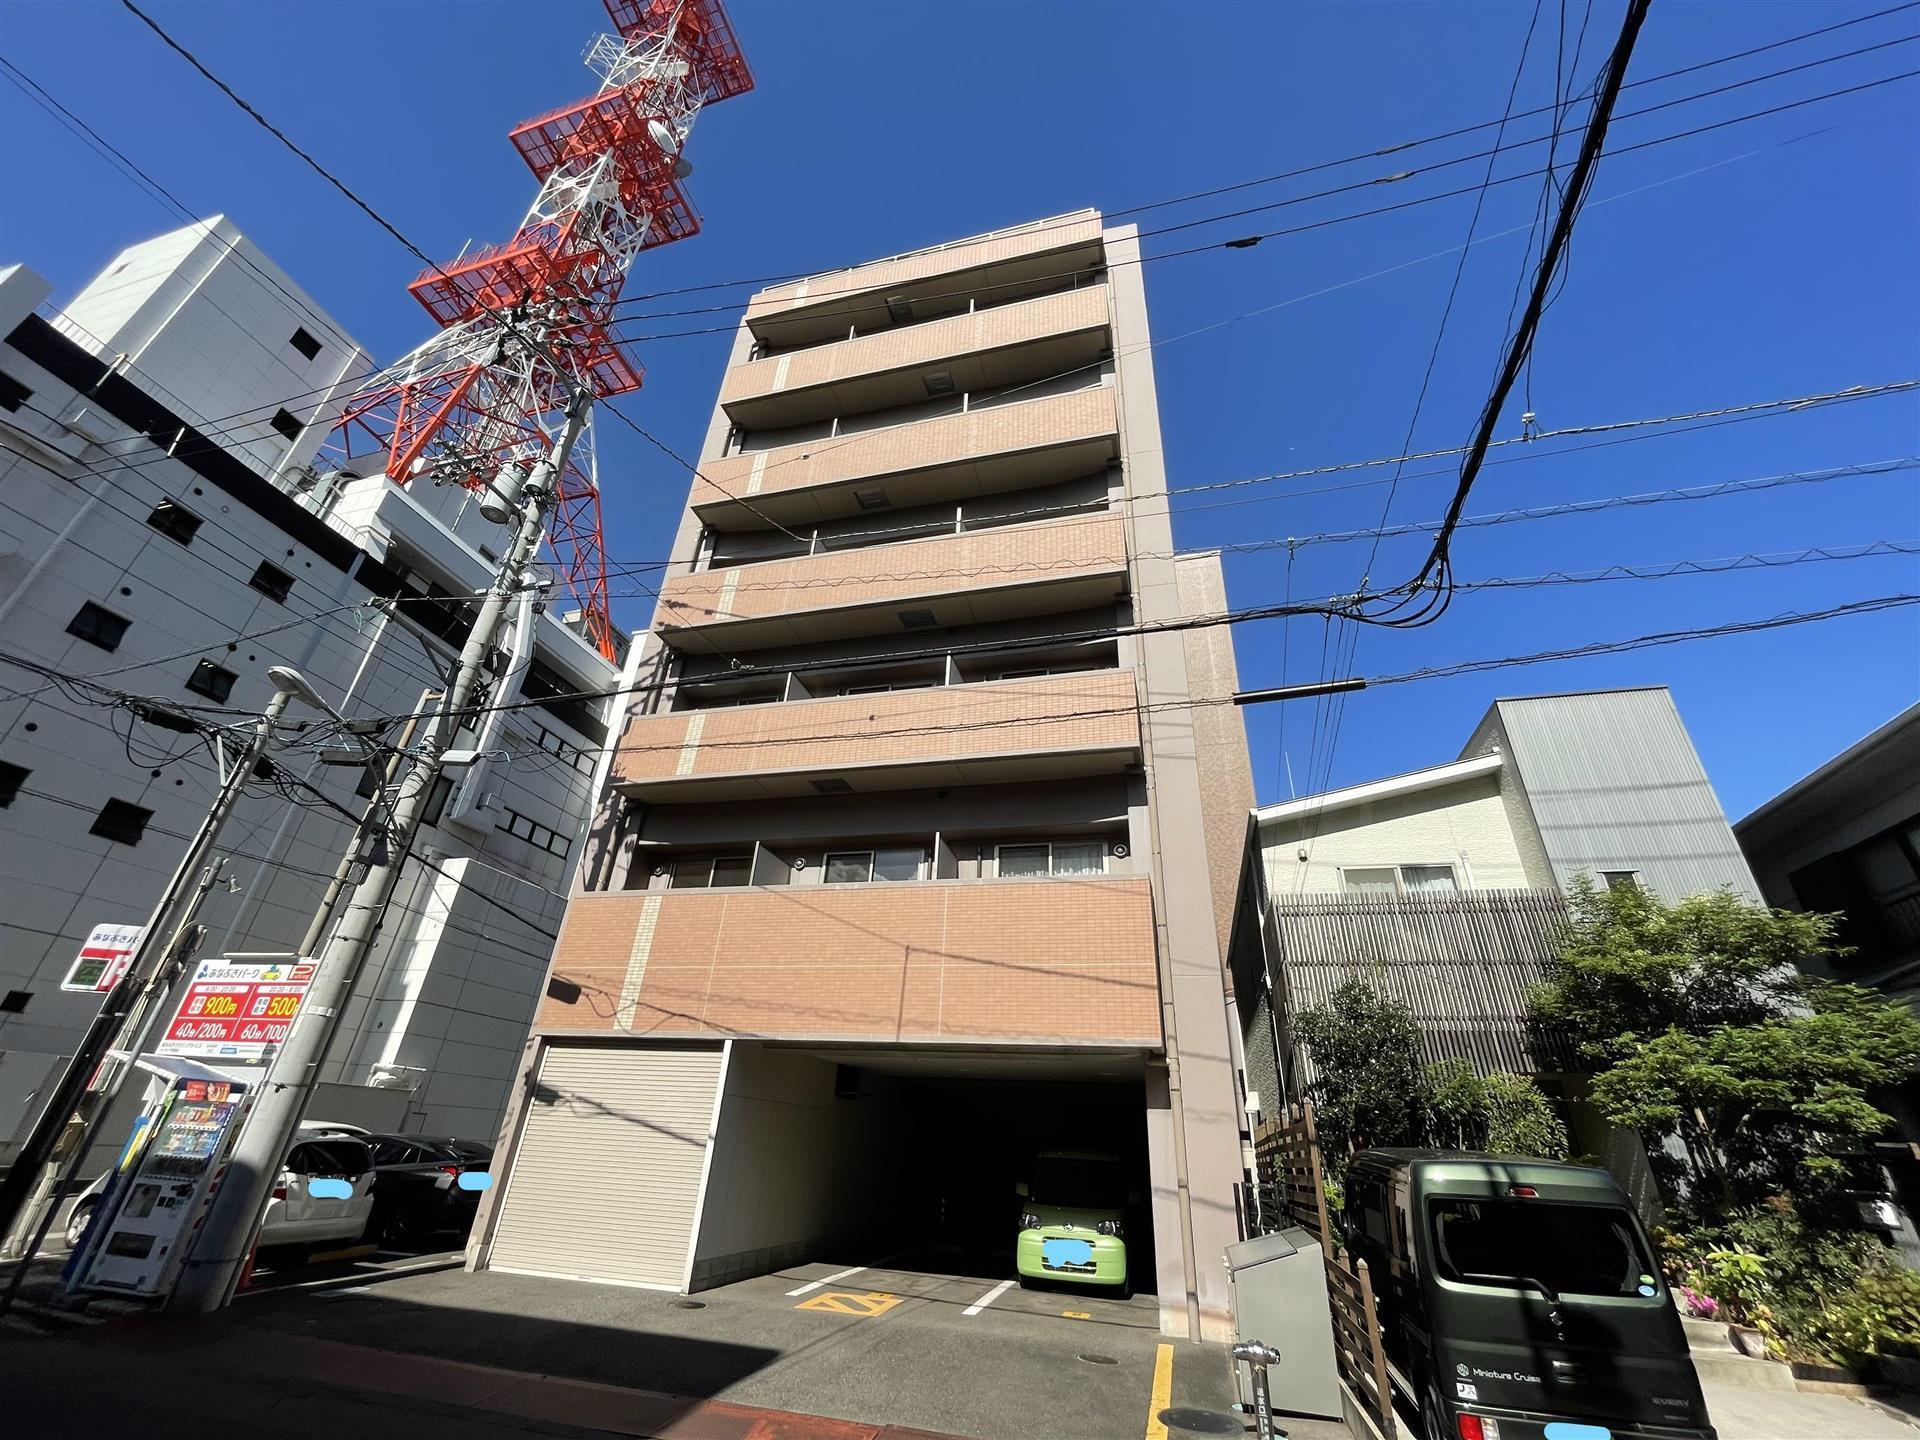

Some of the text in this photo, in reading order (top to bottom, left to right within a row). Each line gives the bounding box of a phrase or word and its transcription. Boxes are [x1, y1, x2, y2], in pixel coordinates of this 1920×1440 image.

[208, 968, 260, 979] あなぶきパーク
[204, 996, 238, 1014] 900円
[1473, 1367, 1541, 1383] Miniature Cruise
[1256, 1387, 1266, 1415] 送水口
